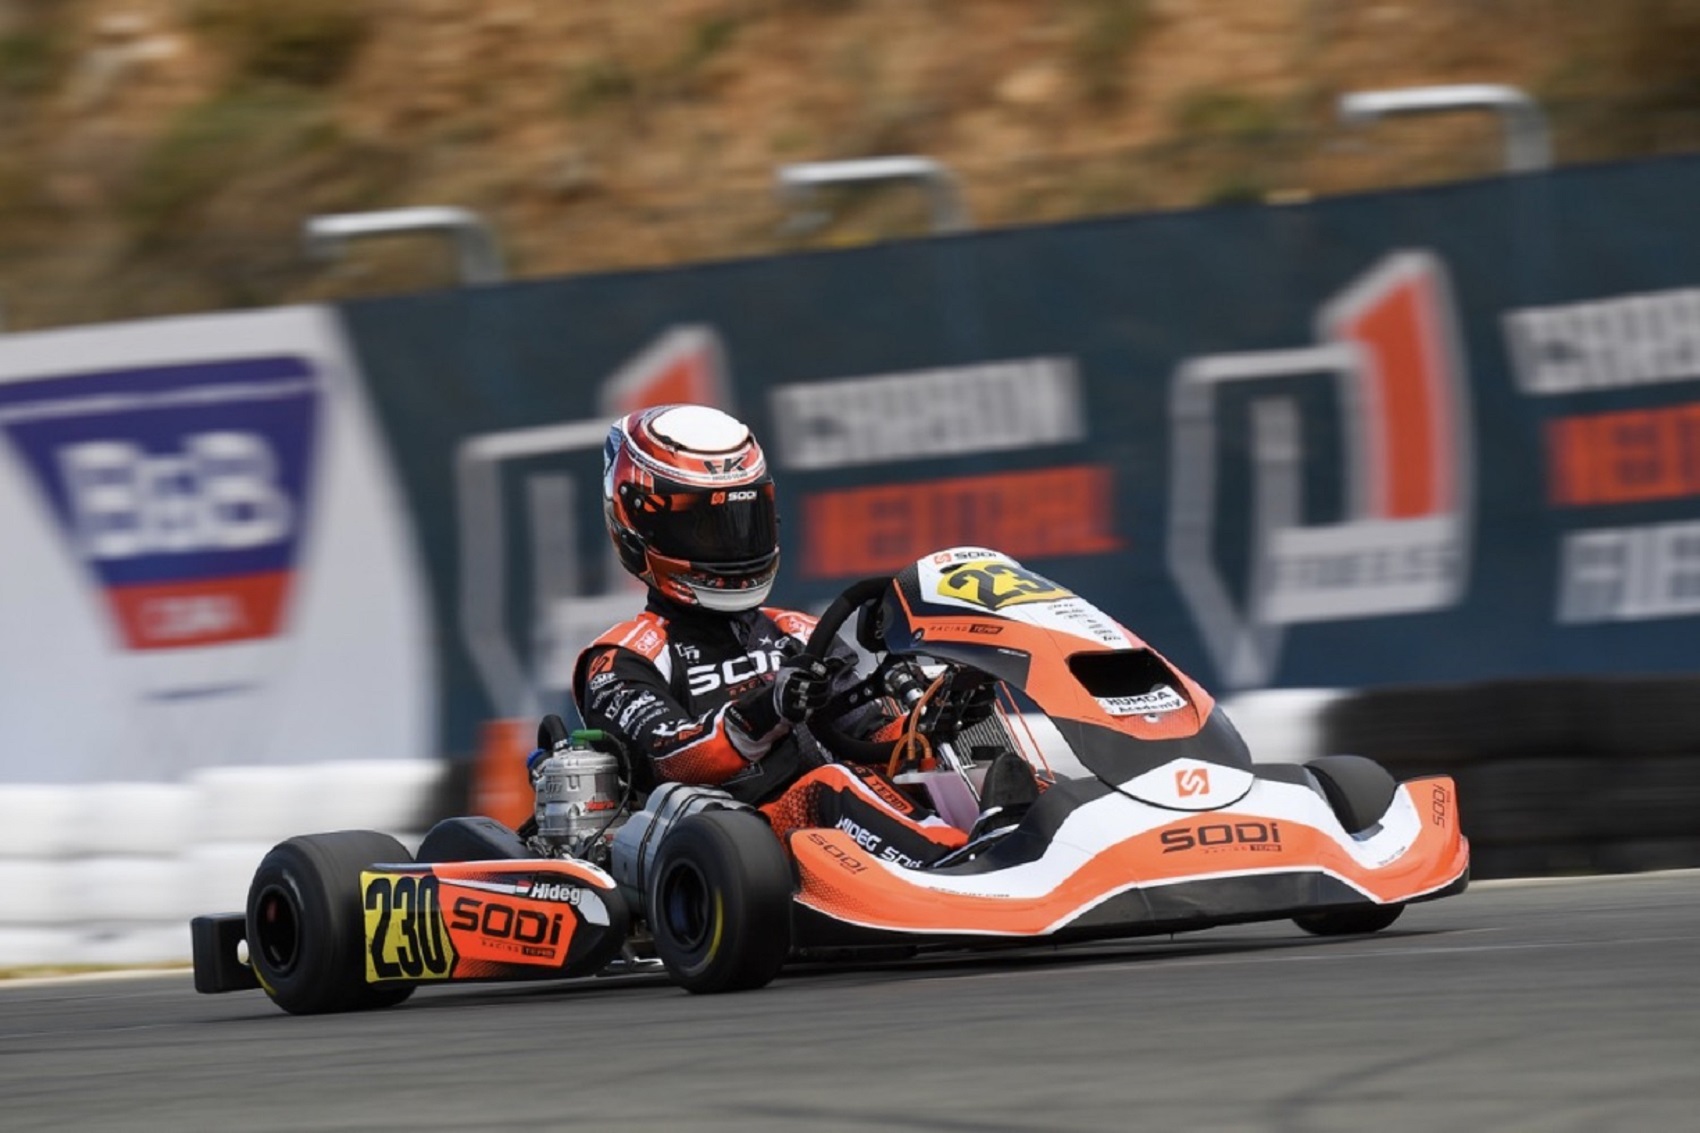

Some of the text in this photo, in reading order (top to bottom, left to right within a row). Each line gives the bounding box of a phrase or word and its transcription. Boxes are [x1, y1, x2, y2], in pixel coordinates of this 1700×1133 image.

[1105, 691, 1172, 706] HUMDA
[529, 882, 581, 905] Hideg
[365, 875, 448, 979] 230
